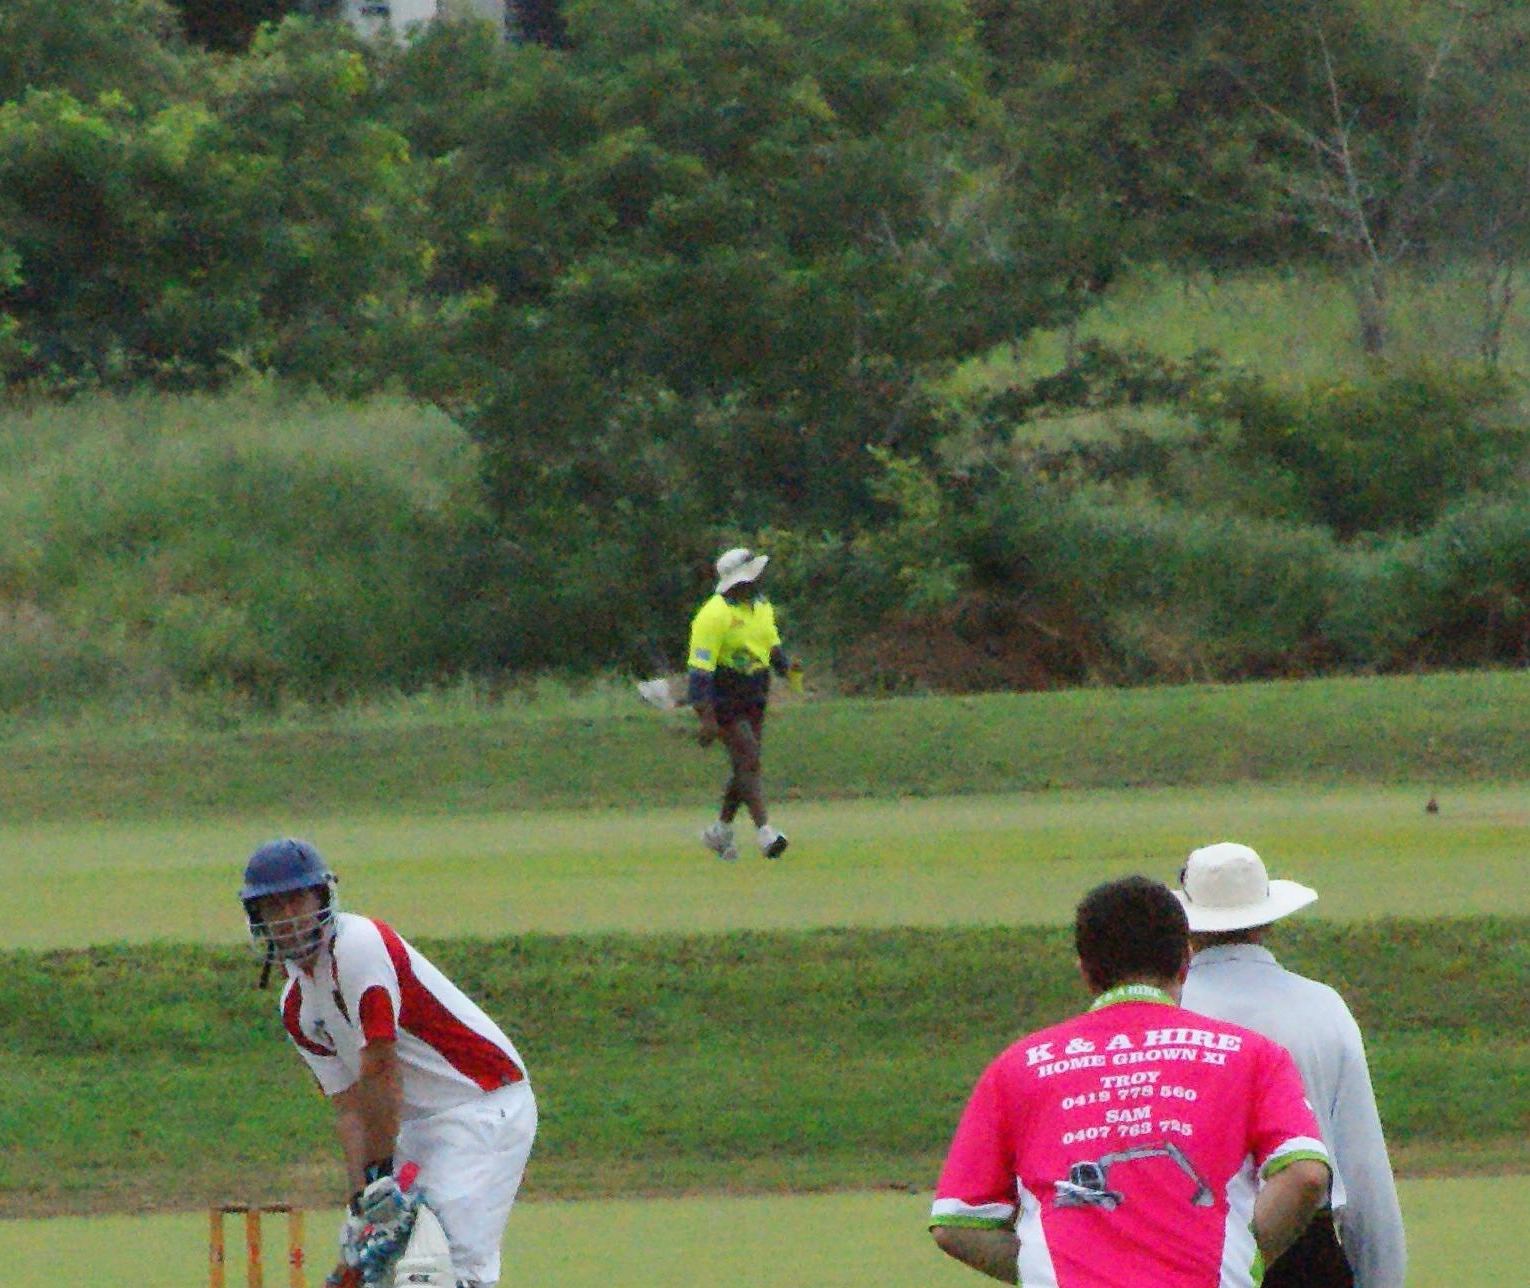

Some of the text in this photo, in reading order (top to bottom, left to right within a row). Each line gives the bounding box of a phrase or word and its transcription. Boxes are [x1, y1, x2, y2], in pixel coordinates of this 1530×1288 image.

[1027, 1029, 1243, 1067] K & A HIRE
[1038, 1048, 1227, 1078] HOME GROWN XI
[1100, 1071, 1161, 1089] TROY
[1106, 1106, 1152, 1124] SAM
[1063, 1126, 1111, 1145] 0407
